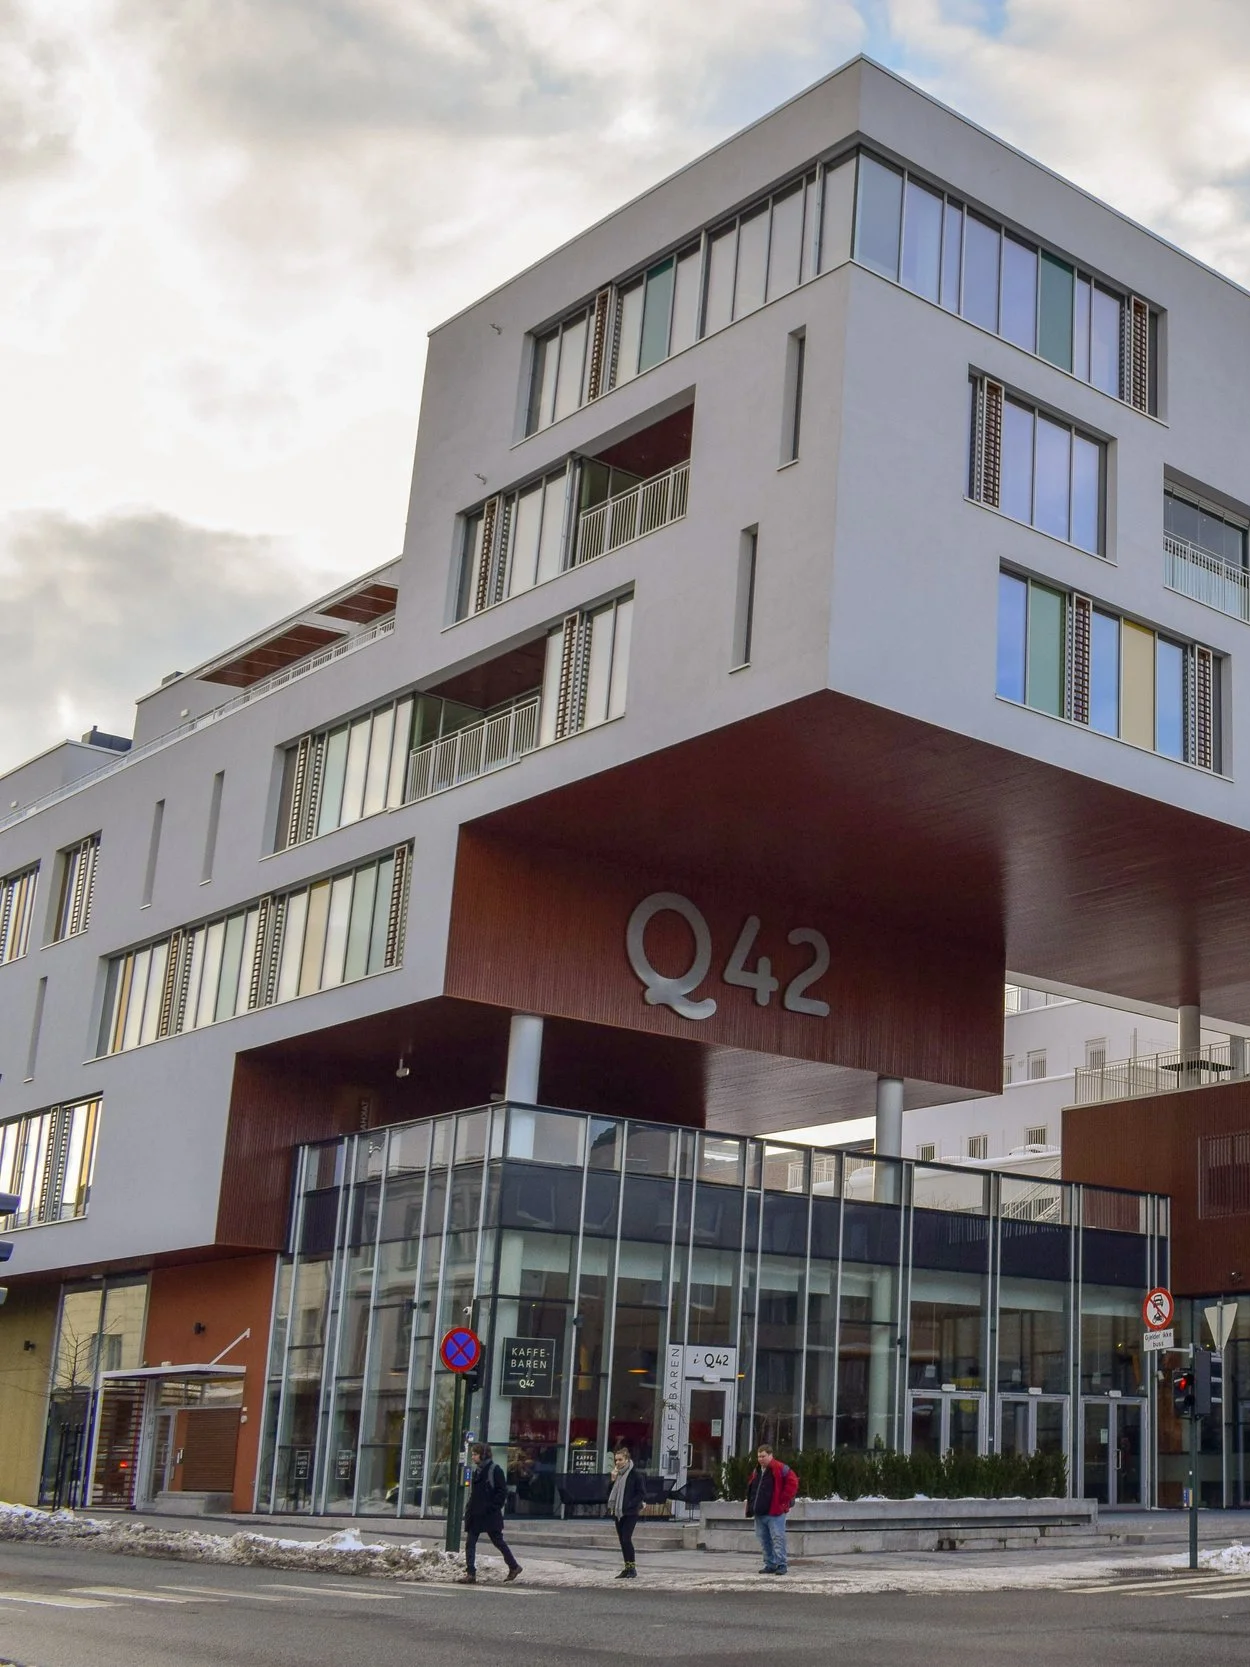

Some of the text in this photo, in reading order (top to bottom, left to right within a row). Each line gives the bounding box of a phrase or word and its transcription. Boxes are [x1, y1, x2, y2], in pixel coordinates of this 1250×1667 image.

[626, 891, 831, 1020] Q42
[511, 1347, 550, 1357] KAFFE-
[510, 1359, 547, 1369] BAREN
[704, 1353, 729, 1368] Q42
[519, 1379, 535, 1389] Q42
